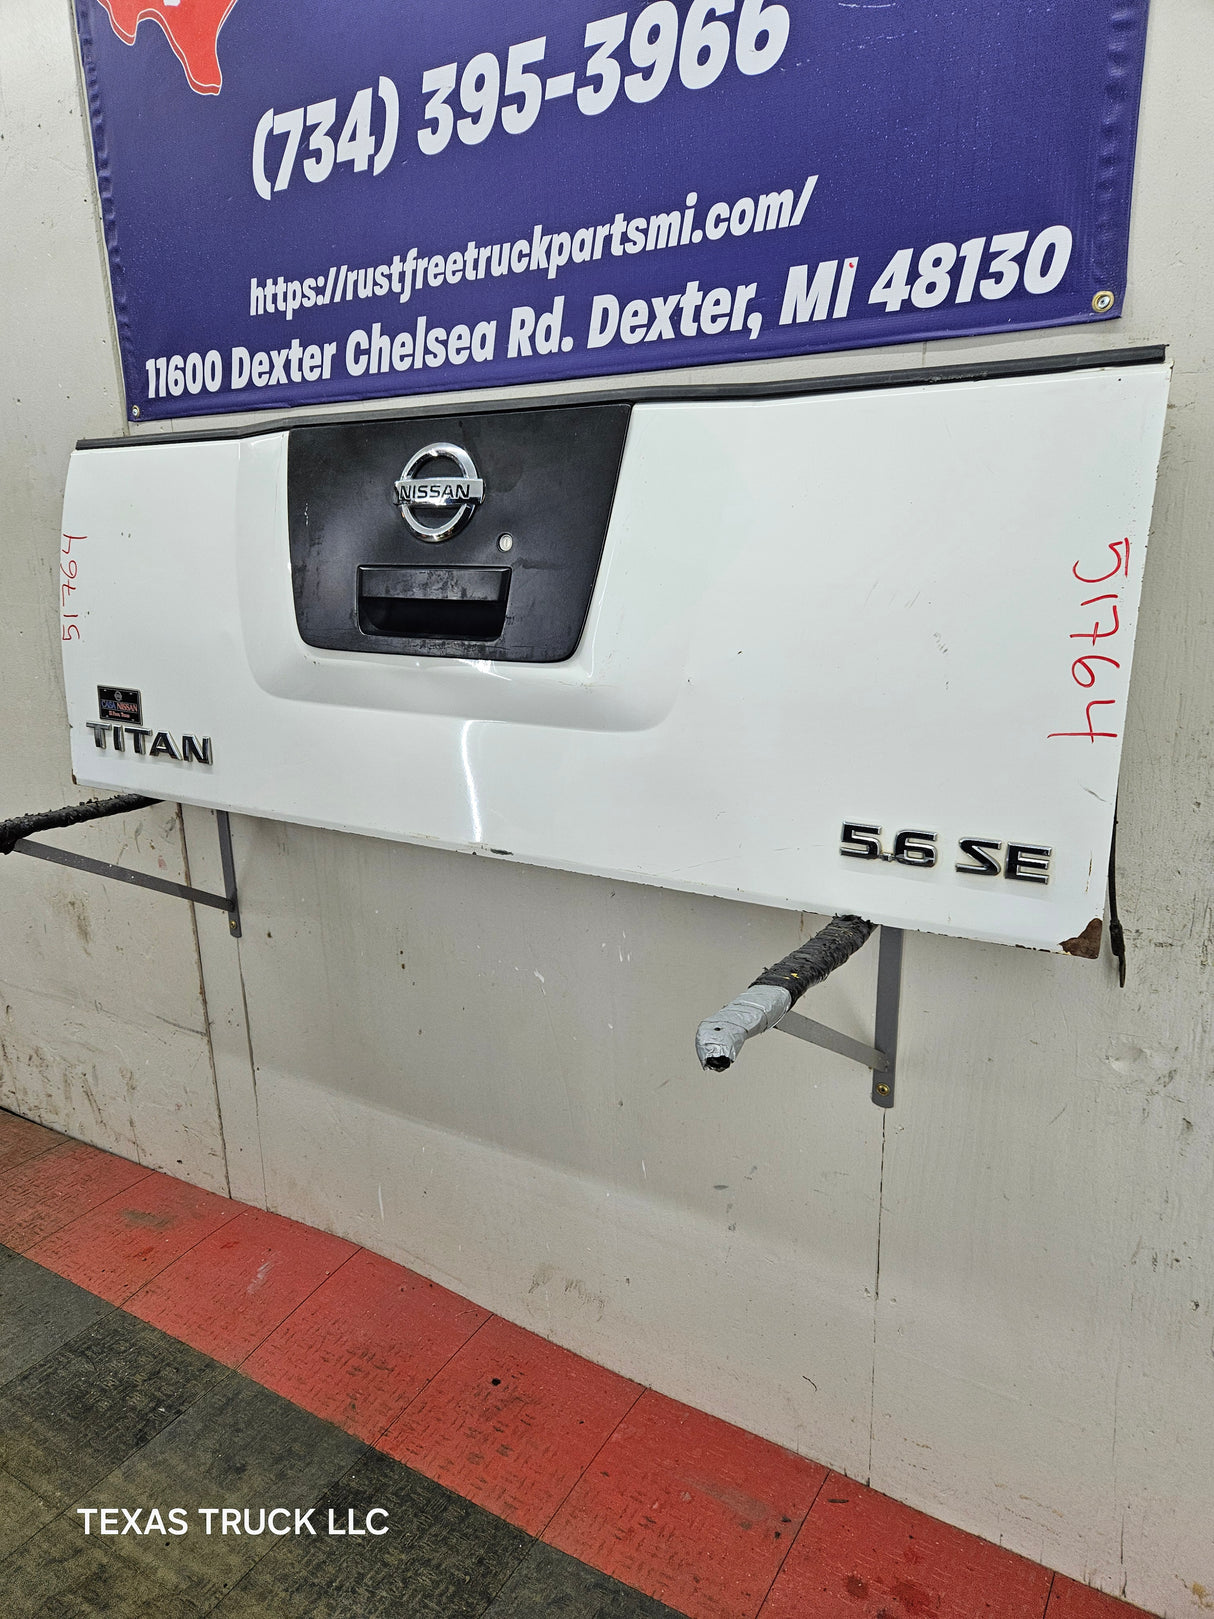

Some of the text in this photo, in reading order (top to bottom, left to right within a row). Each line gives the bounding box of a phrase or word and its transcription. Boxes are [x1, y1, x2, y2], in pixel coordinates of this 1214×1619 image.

[252, 0, 791, 201] (734) 395-3966
[249, 174, 819, 320] https://rustfreetruckpartsmi.com/
[145, 224, 1074, 399] 11600 Dexter Chelsea Rd. Dexter, MI 48130
[399, 484, 471, 501] NISSAN
[61, 533, 88, 641] 51764
[1046, 537, 1131, 744] 51764
[85, 720, 213, 765] TITAN
[117, 702, 138, 712] NISSAN
[839, 818, 1053, 885] 5.6 SE
